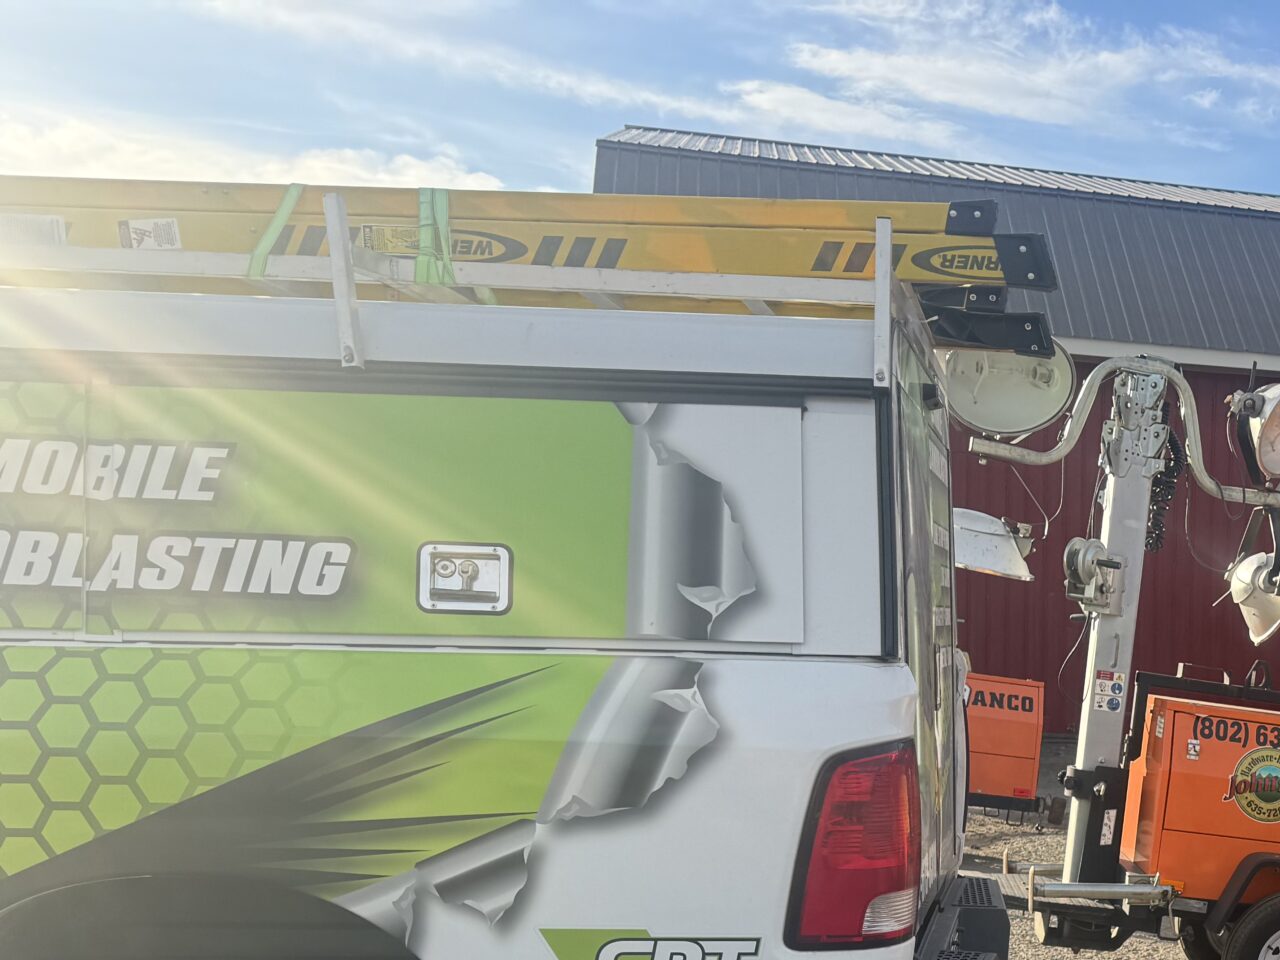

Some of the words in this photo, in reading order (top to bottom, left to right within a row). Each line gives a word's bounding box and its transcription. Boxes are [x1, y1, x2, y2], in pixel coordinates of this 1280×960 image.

[940, 253, 1002, 271] RNER
[0, 529, 352, 596] BLASTING
[972, 690, 1034, 713] ANCO
[1192, 715, 1249, 748] (802)
